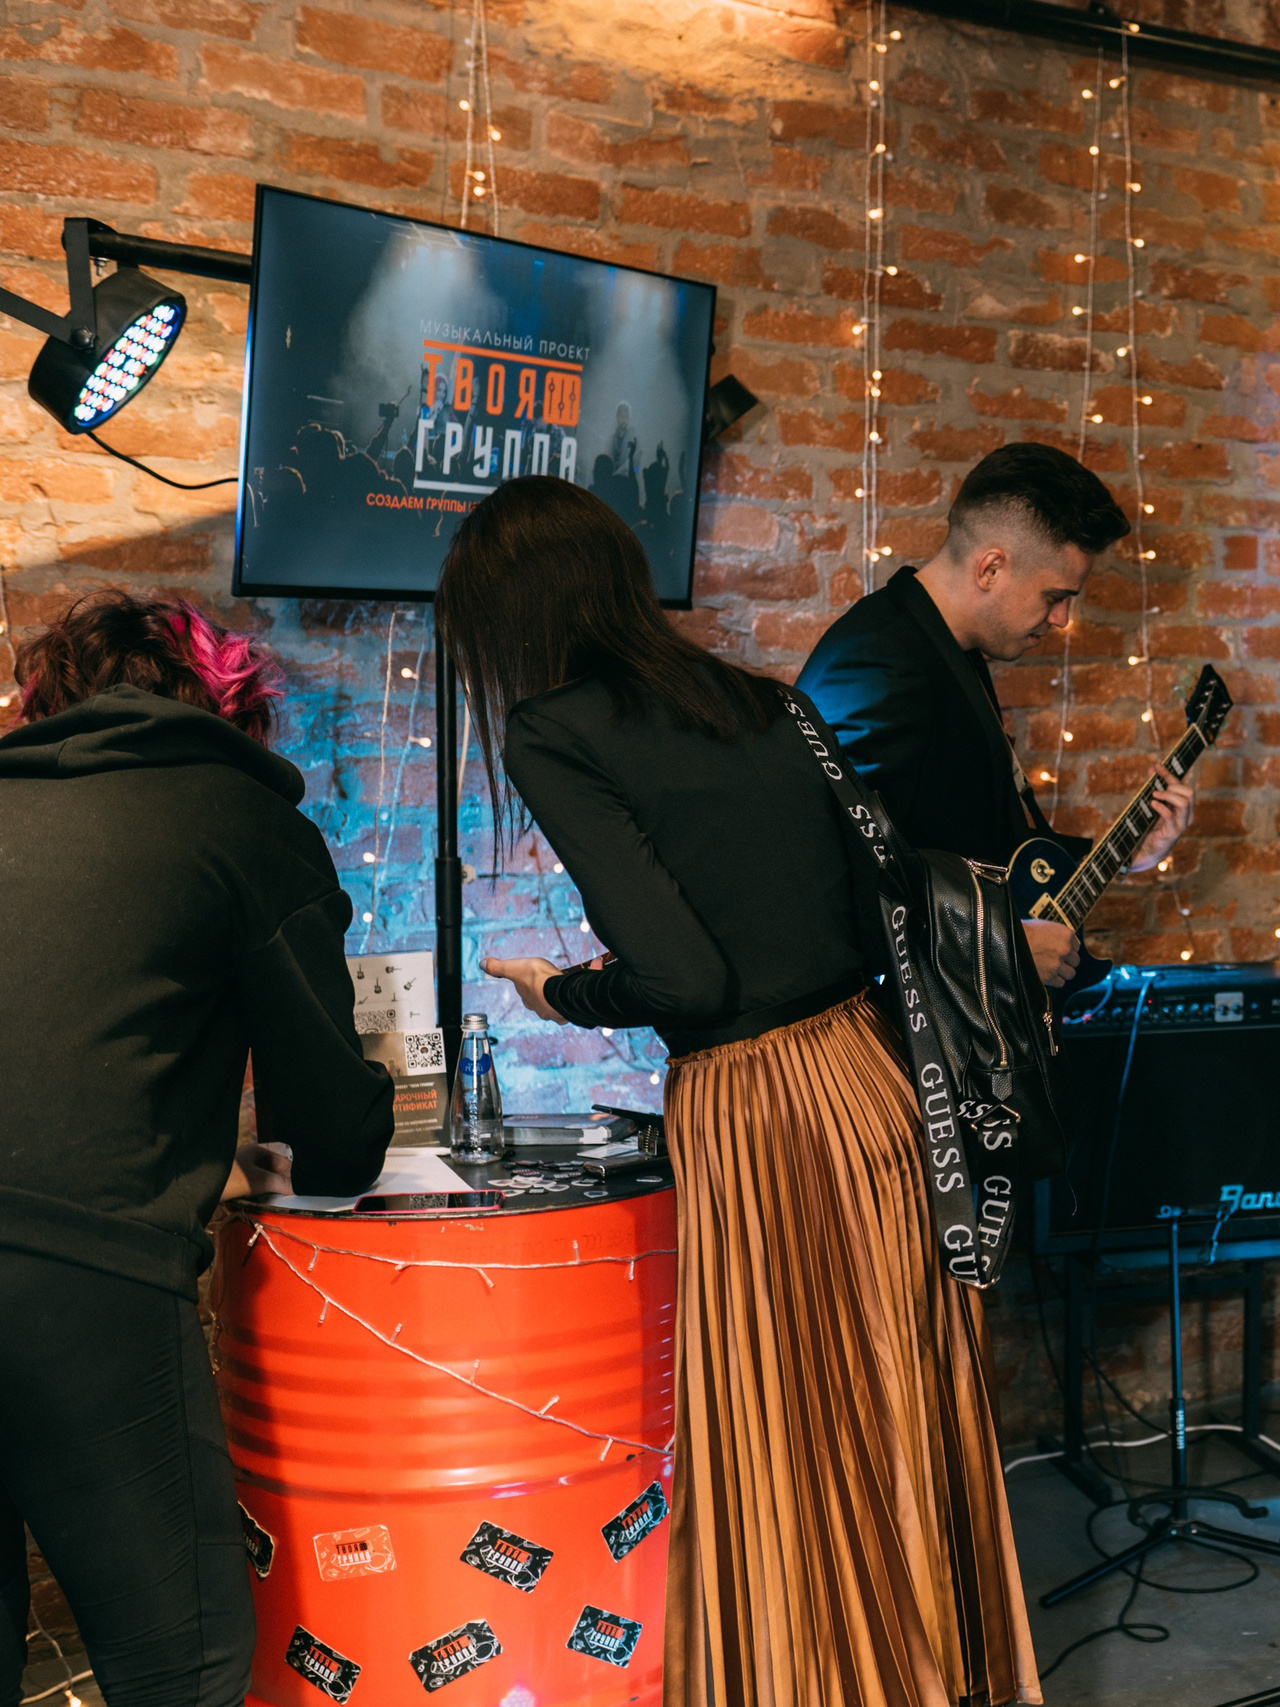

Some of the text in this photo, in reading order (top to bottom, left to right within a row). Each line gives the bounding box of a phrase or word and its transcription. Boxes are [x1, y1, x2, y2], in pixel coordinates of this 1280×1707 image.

[419, 319, 591, 361] МУЗЫКАЛЬНЫЙ ПРОЕКТ
[423, 352, 537, 420] ТВОЯ
[415, 419, 577, 484] ГРУППА
[366, 492, 424, 510] СОЗДАЕМ
[426, 497, 466, 513] ГРУППЫ
[892, 905, 927, 1033] GUESS
[393, 1100, 437, 1113] РТИФИКАТ
[395, 1089, 437, 1102] АРОЧНЫЙ
[921, 1062, 965, 1193] GUESS
[487, 1549, 523, 1573] ГРУППА
